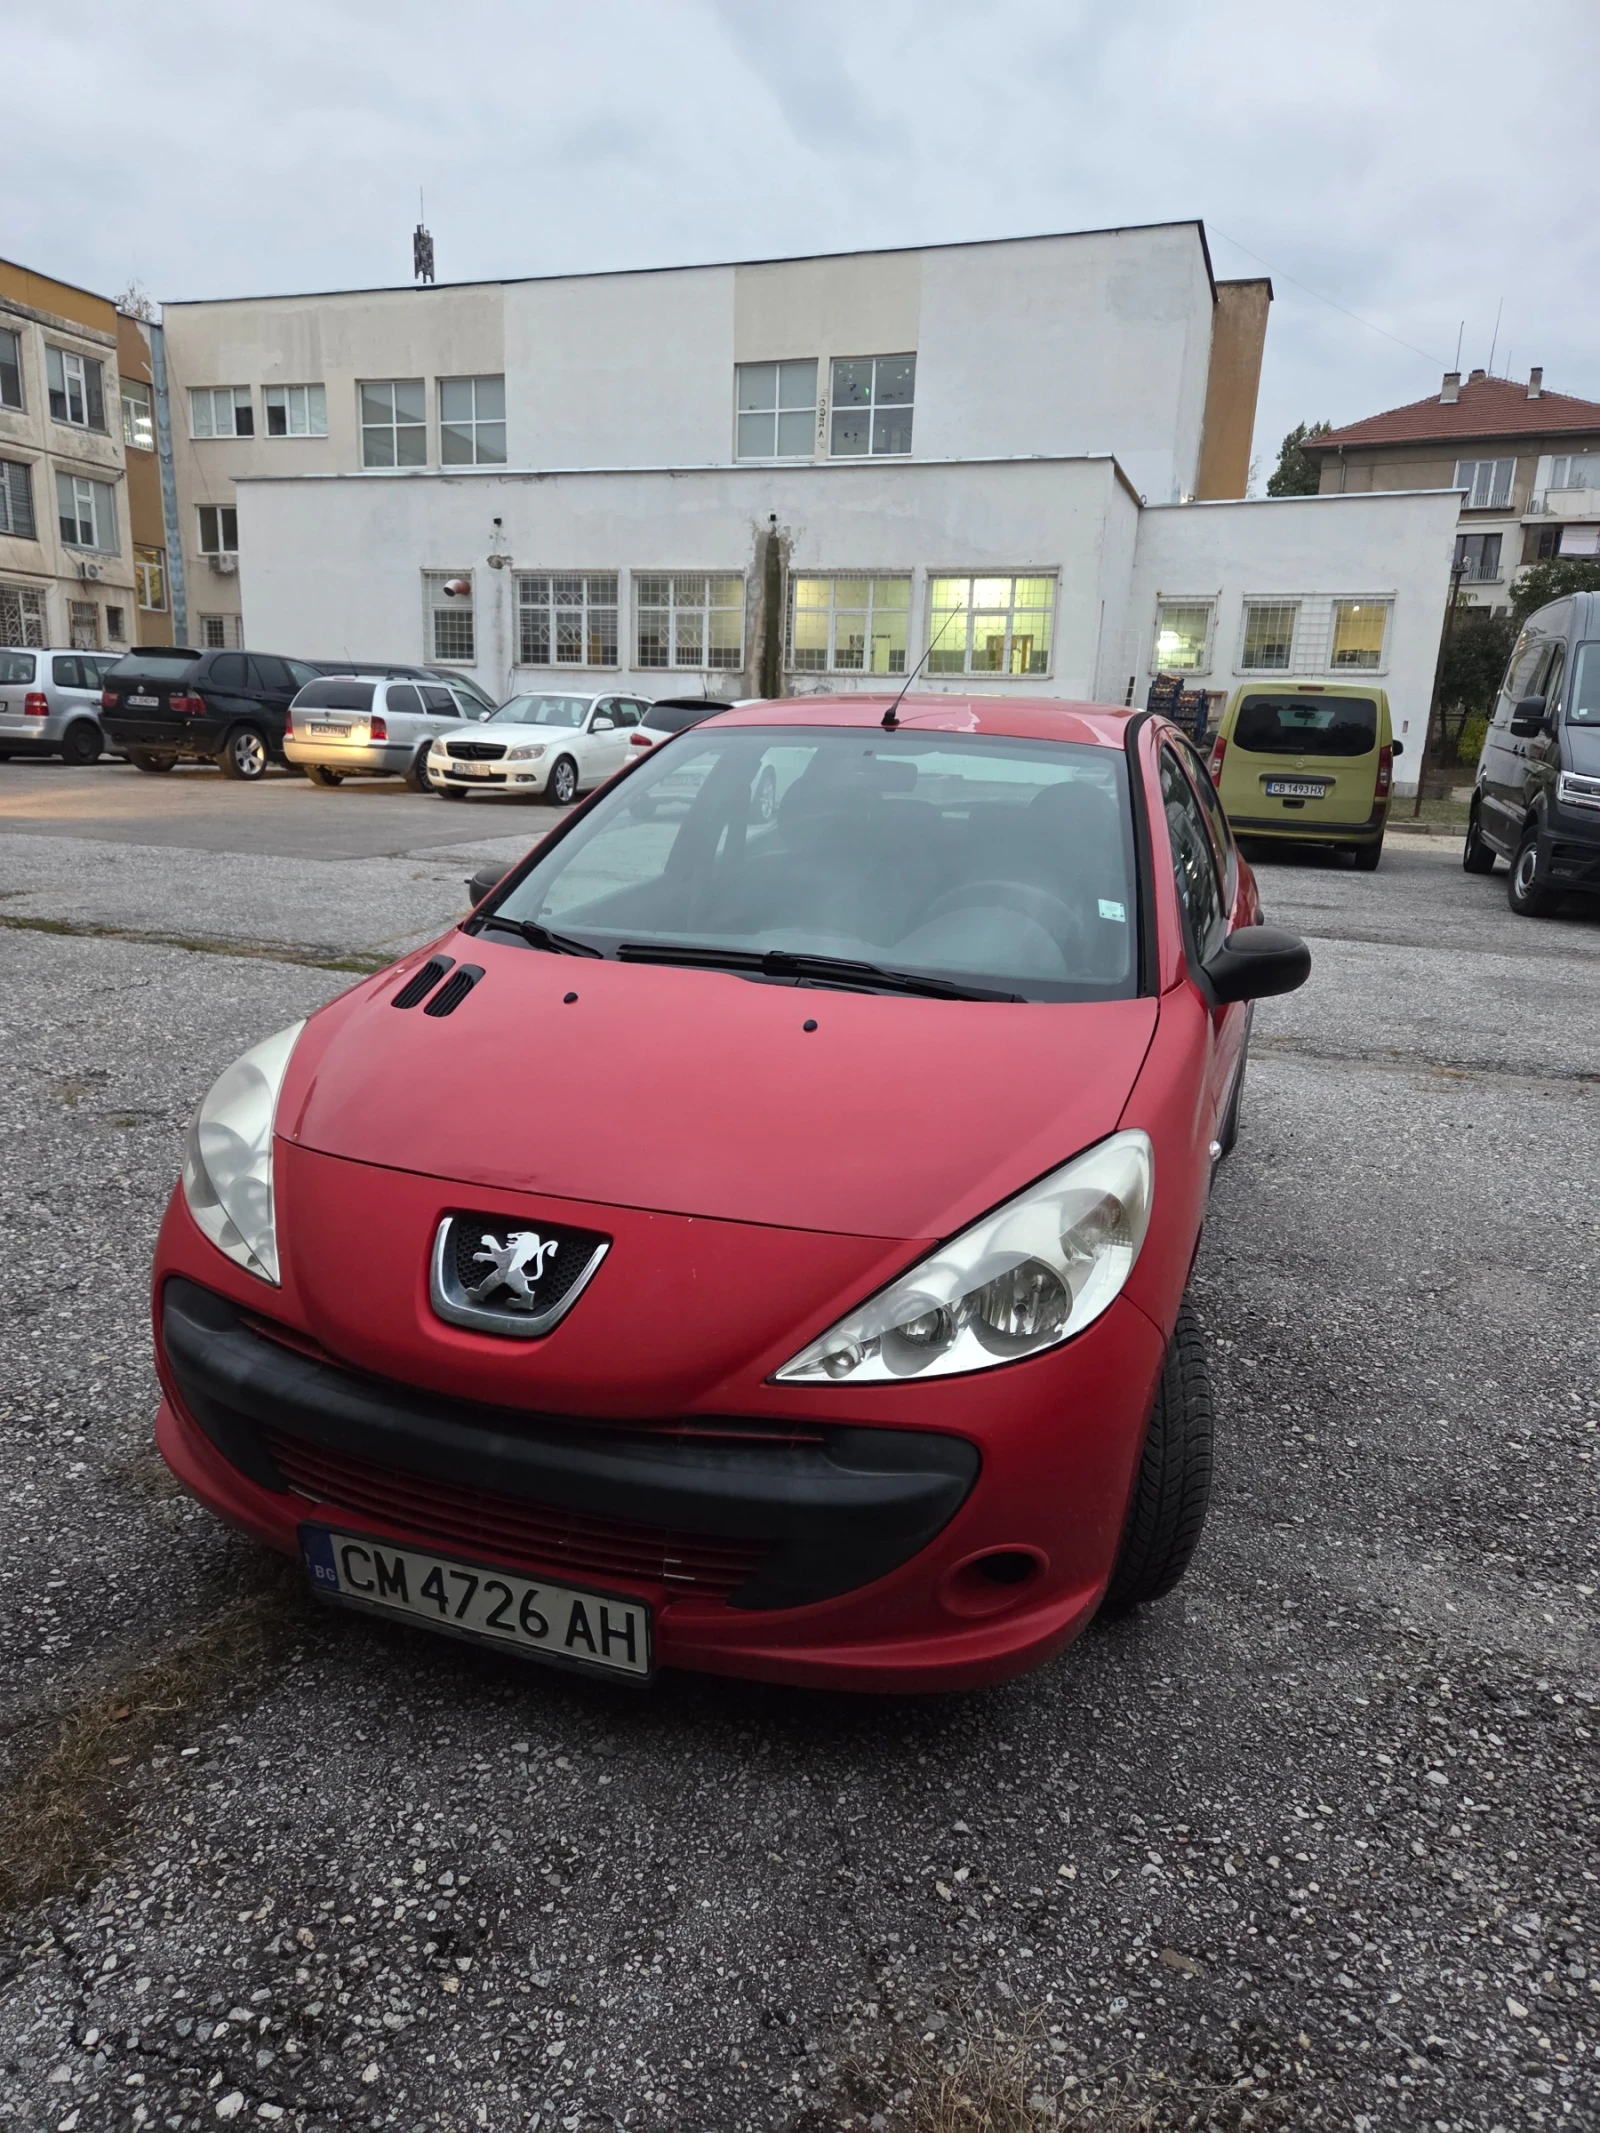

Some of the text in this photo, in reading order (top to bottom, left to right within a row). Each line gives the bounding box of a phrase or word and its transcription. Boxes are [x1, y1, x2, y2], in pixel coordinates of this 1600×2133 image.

[1273, 783, 1323, 795] CB 1493 HX
[314, 1564, 336, 1582] BG
[340, 1544, 637, 1663] CM 4726 AH
